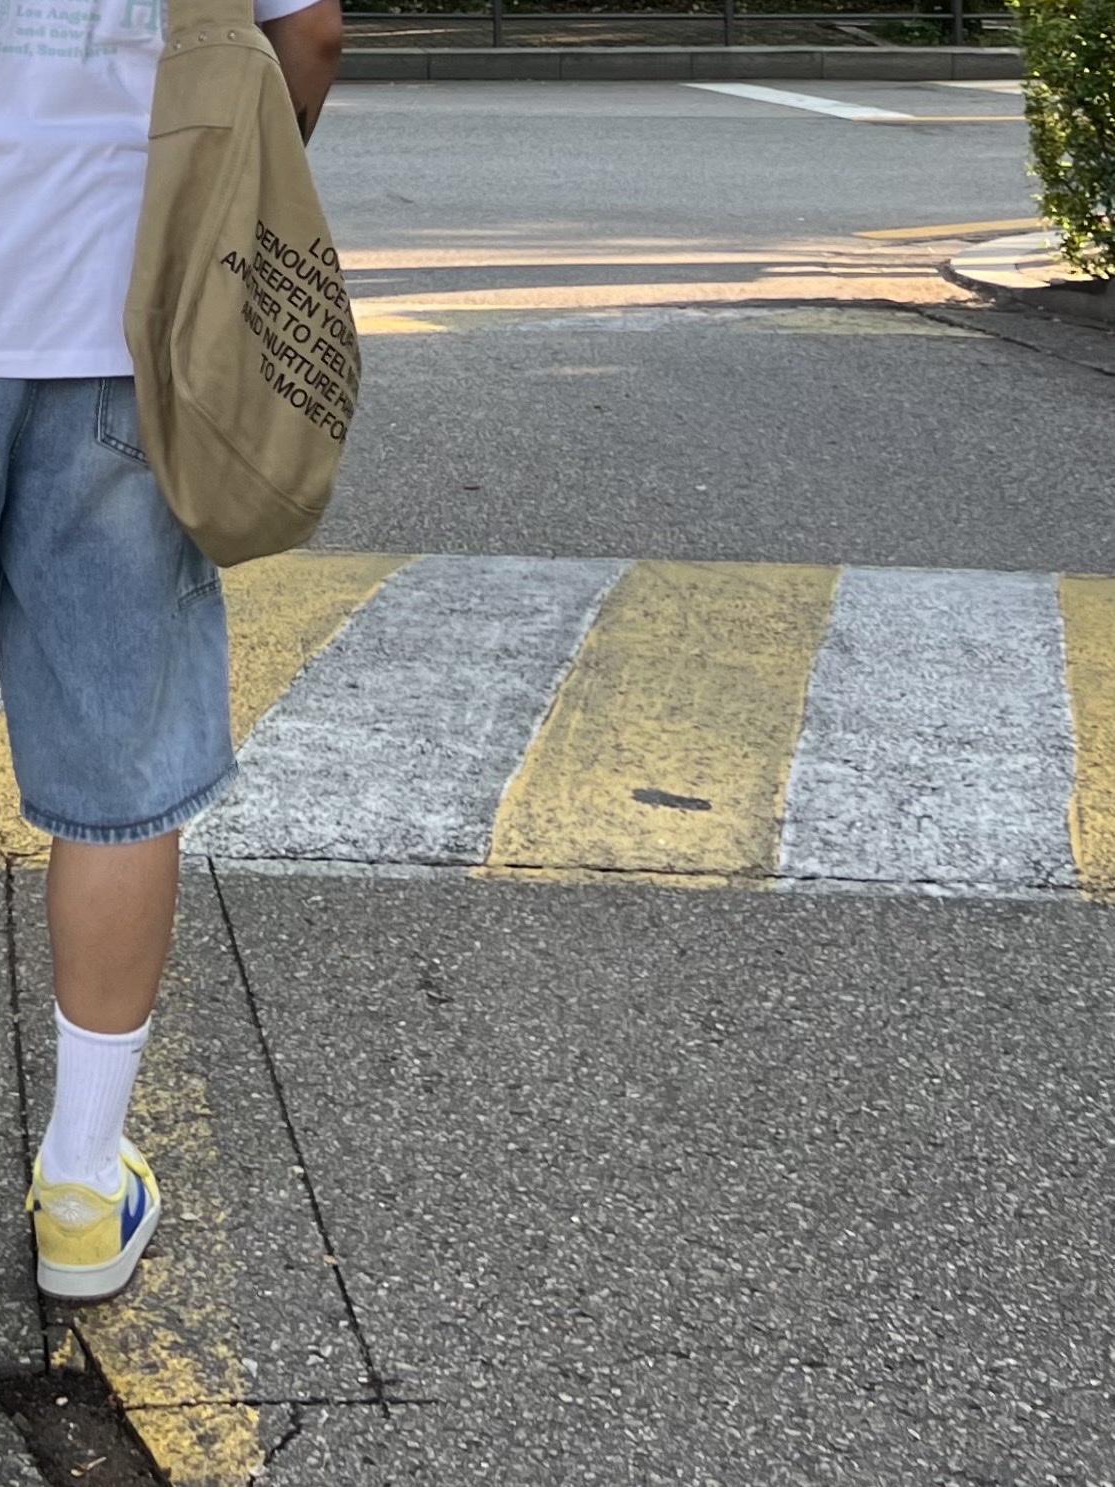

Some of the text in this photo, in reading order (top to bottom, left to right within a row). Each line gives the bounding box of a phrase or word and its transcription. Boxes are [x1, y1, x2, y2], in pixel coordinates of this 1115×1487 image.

[253, 251, 320, 319] DEEPEN
[263, 326, 340, 403] NURTURE
[283, 311, 311, 343] TO
[311, 337, 345, 379] FEEL
[260, 353, 275, 383] TO
[273, 373, 326, 424] MOVE
